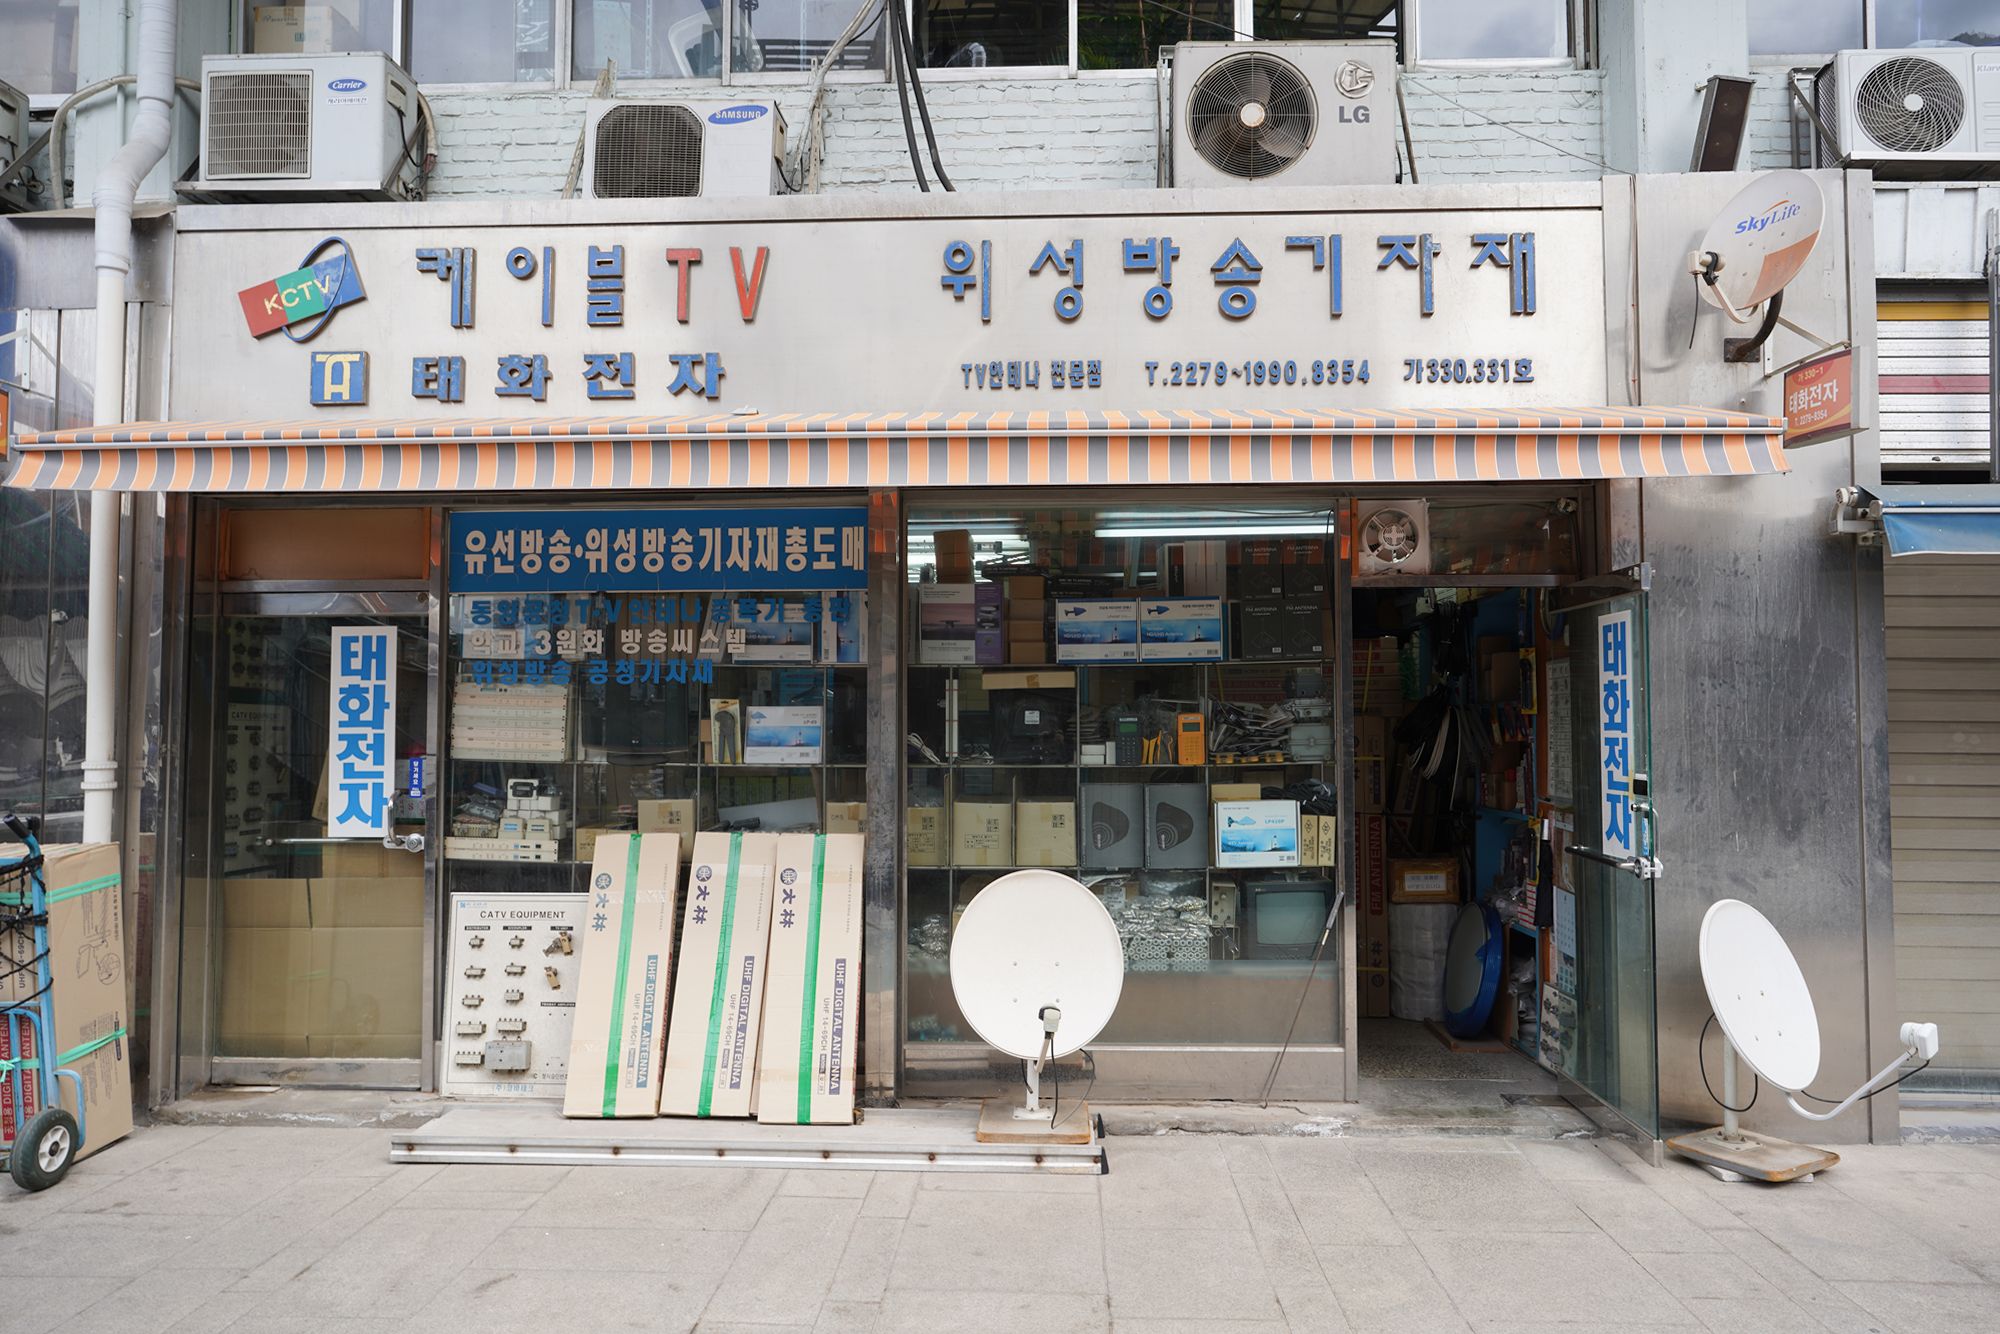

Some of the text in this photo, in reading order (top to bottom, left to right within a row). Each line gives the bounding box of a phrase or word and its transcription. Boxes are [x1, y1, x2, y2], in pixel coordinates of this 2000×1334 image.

[332, 80, 363, 90] Carrier
[716, 110, 761, 119] SAMSUNG
[1338, 105, 1370, 123] LG
[1735, 202, 1801, 234] SkyLife
[415, 244, 770, 329] 케이블 TV
[940, 231, 1537, 323] 위성방송기자재
[263, 274, 331, 315] KCTV
[412, 351, 726, 405] 태화전자
[961, 359, 1102, 390] TV안테나 전문점
[1403, 357, 1535, 385] 가330.331호
[1789, 378, 1839, 414] 태화전자
[471, 629, 518, 655] 학교
[621, 628, 746, 654] 방송씨스템
[472, 659, 572, 686] 위성방송
[336, 635, 390, 828] 태화전자
[1602, 620, 1632, 850] 태화전자
[1369, 819, 1382, 888] ANTENNA
[479, 910, 566, 919] CATV EQUIPMENT
[17, 971, 26, 989] UHF
[729, 993, 737, 1011] UHF
[822, 996, 830, 1014] UHF
[20, 1013, 31, 1057] ANTENN
[637, 958, 657, 1084] UHF DIGITAL ANTENNA
[731, 960, 754, 1085] UHF DIGITAL ANTENNA
[830, 962, 845, 1090] UHF DIGITAL ANTENNA
